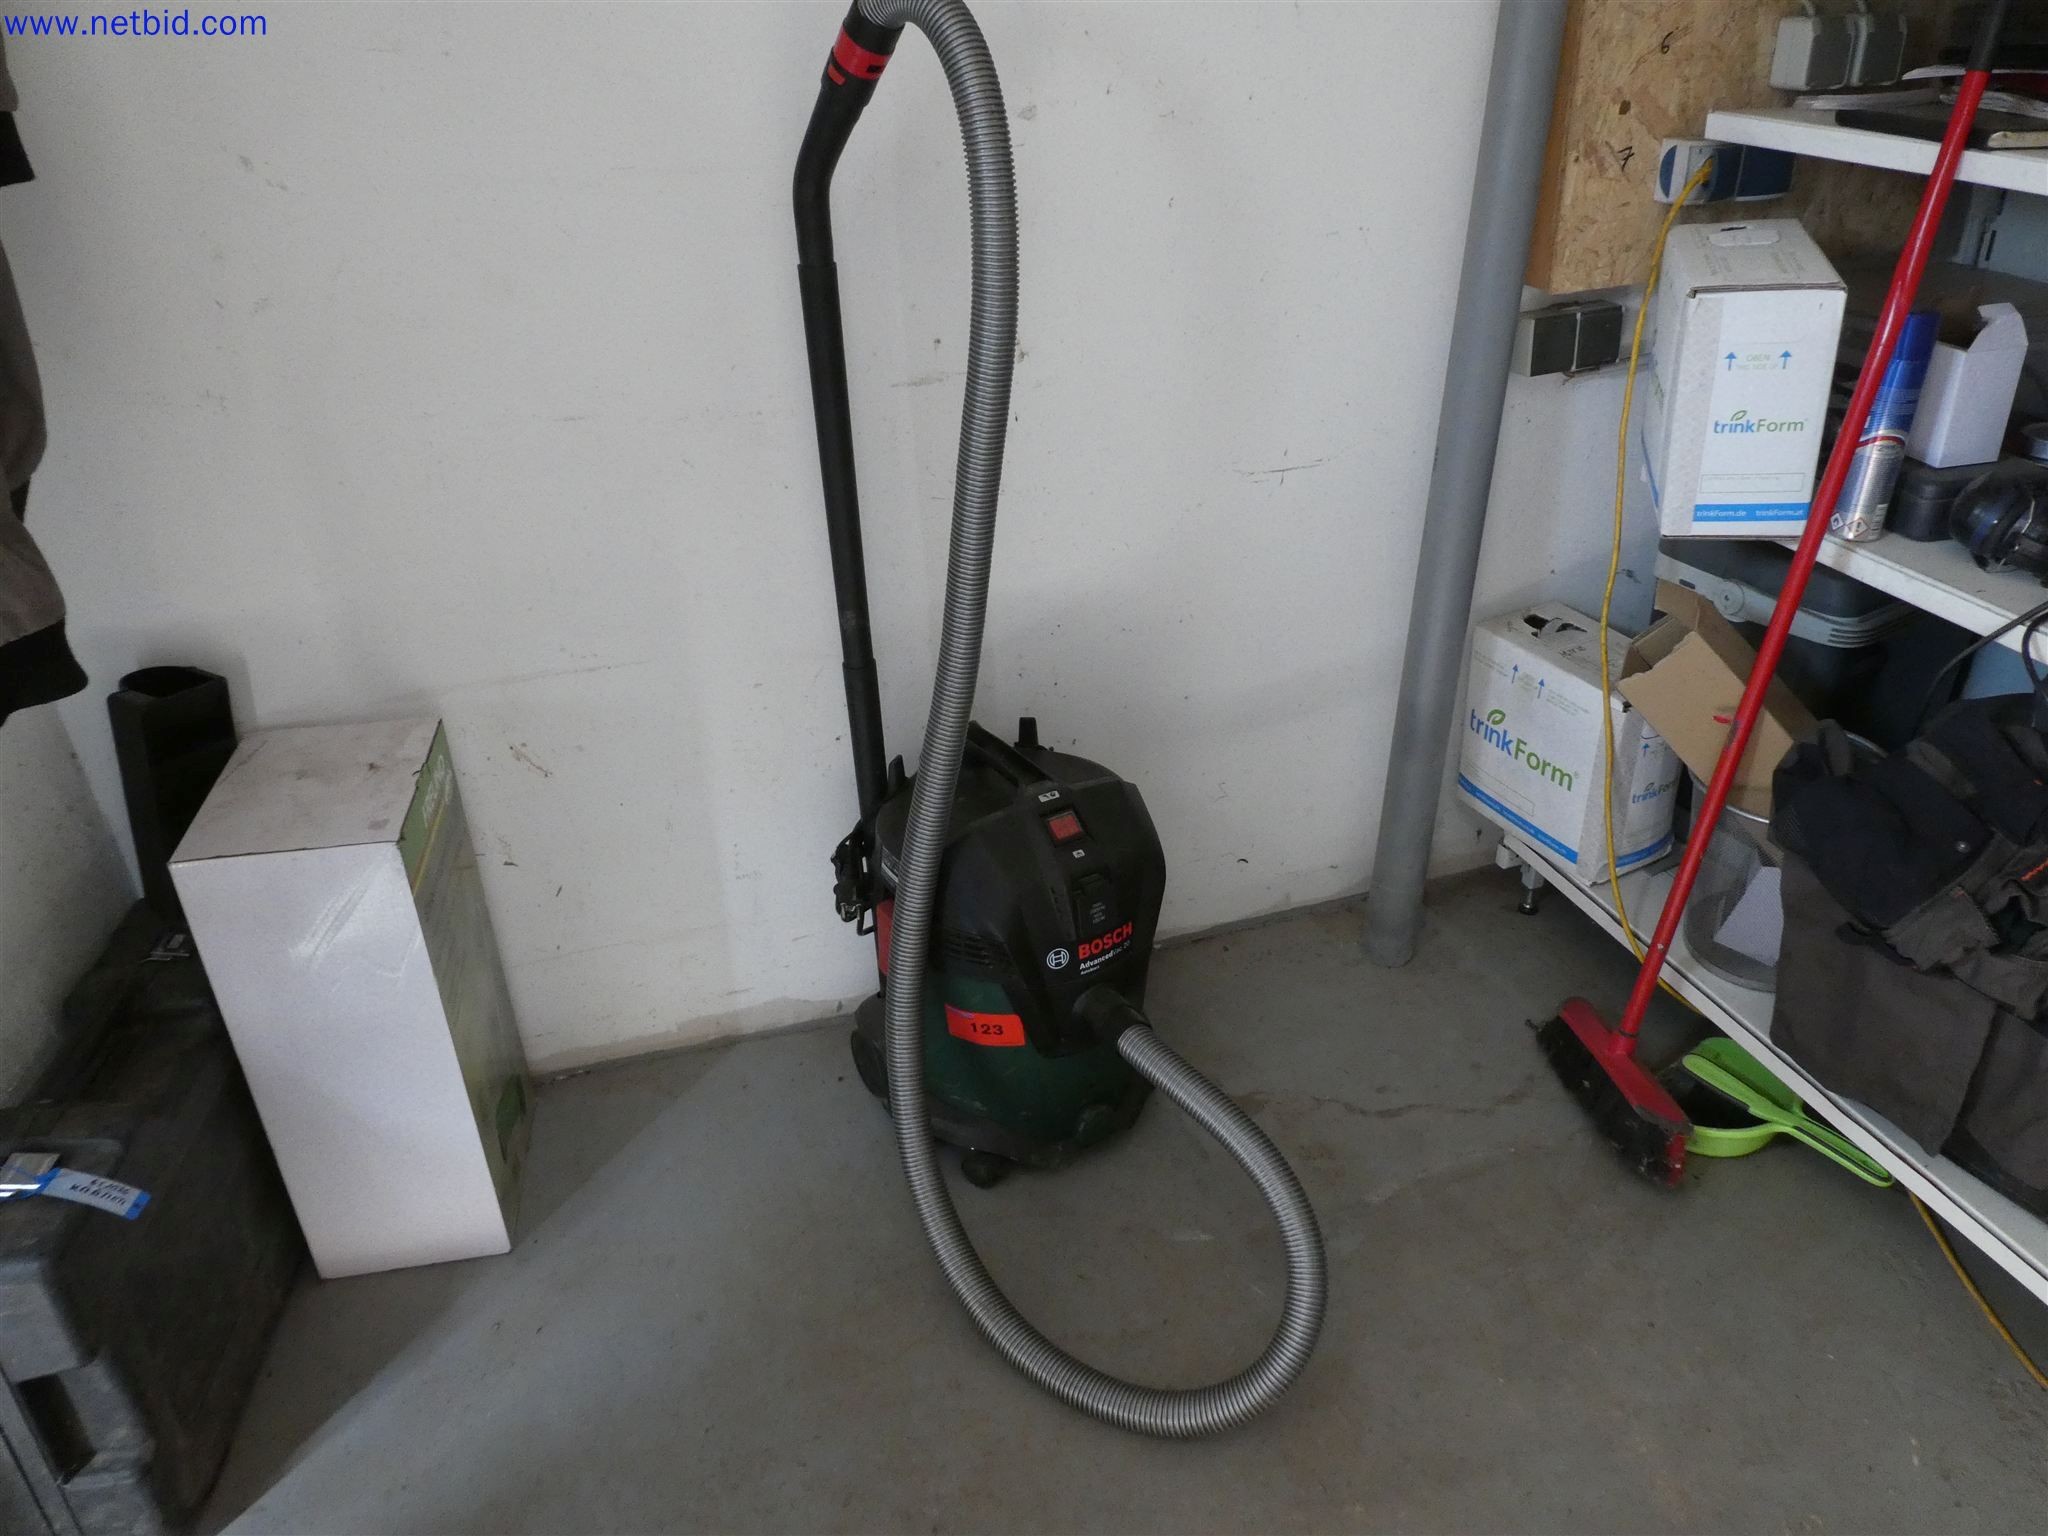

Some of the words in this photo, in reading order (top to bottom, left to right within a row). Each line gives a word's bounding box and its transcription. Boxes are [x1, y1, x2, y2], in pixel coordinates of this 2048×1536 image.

[1660, 30, 1674, 55] 6
[1617, 145, 1635, 173] 7
[1713, 413, 1805, 434] trinkForm
[1470, 709, 1574, 793] trinkForm
[1078, 921, 1133, 960] BOSCH
[970, 1022, 1004, 1036] 123
